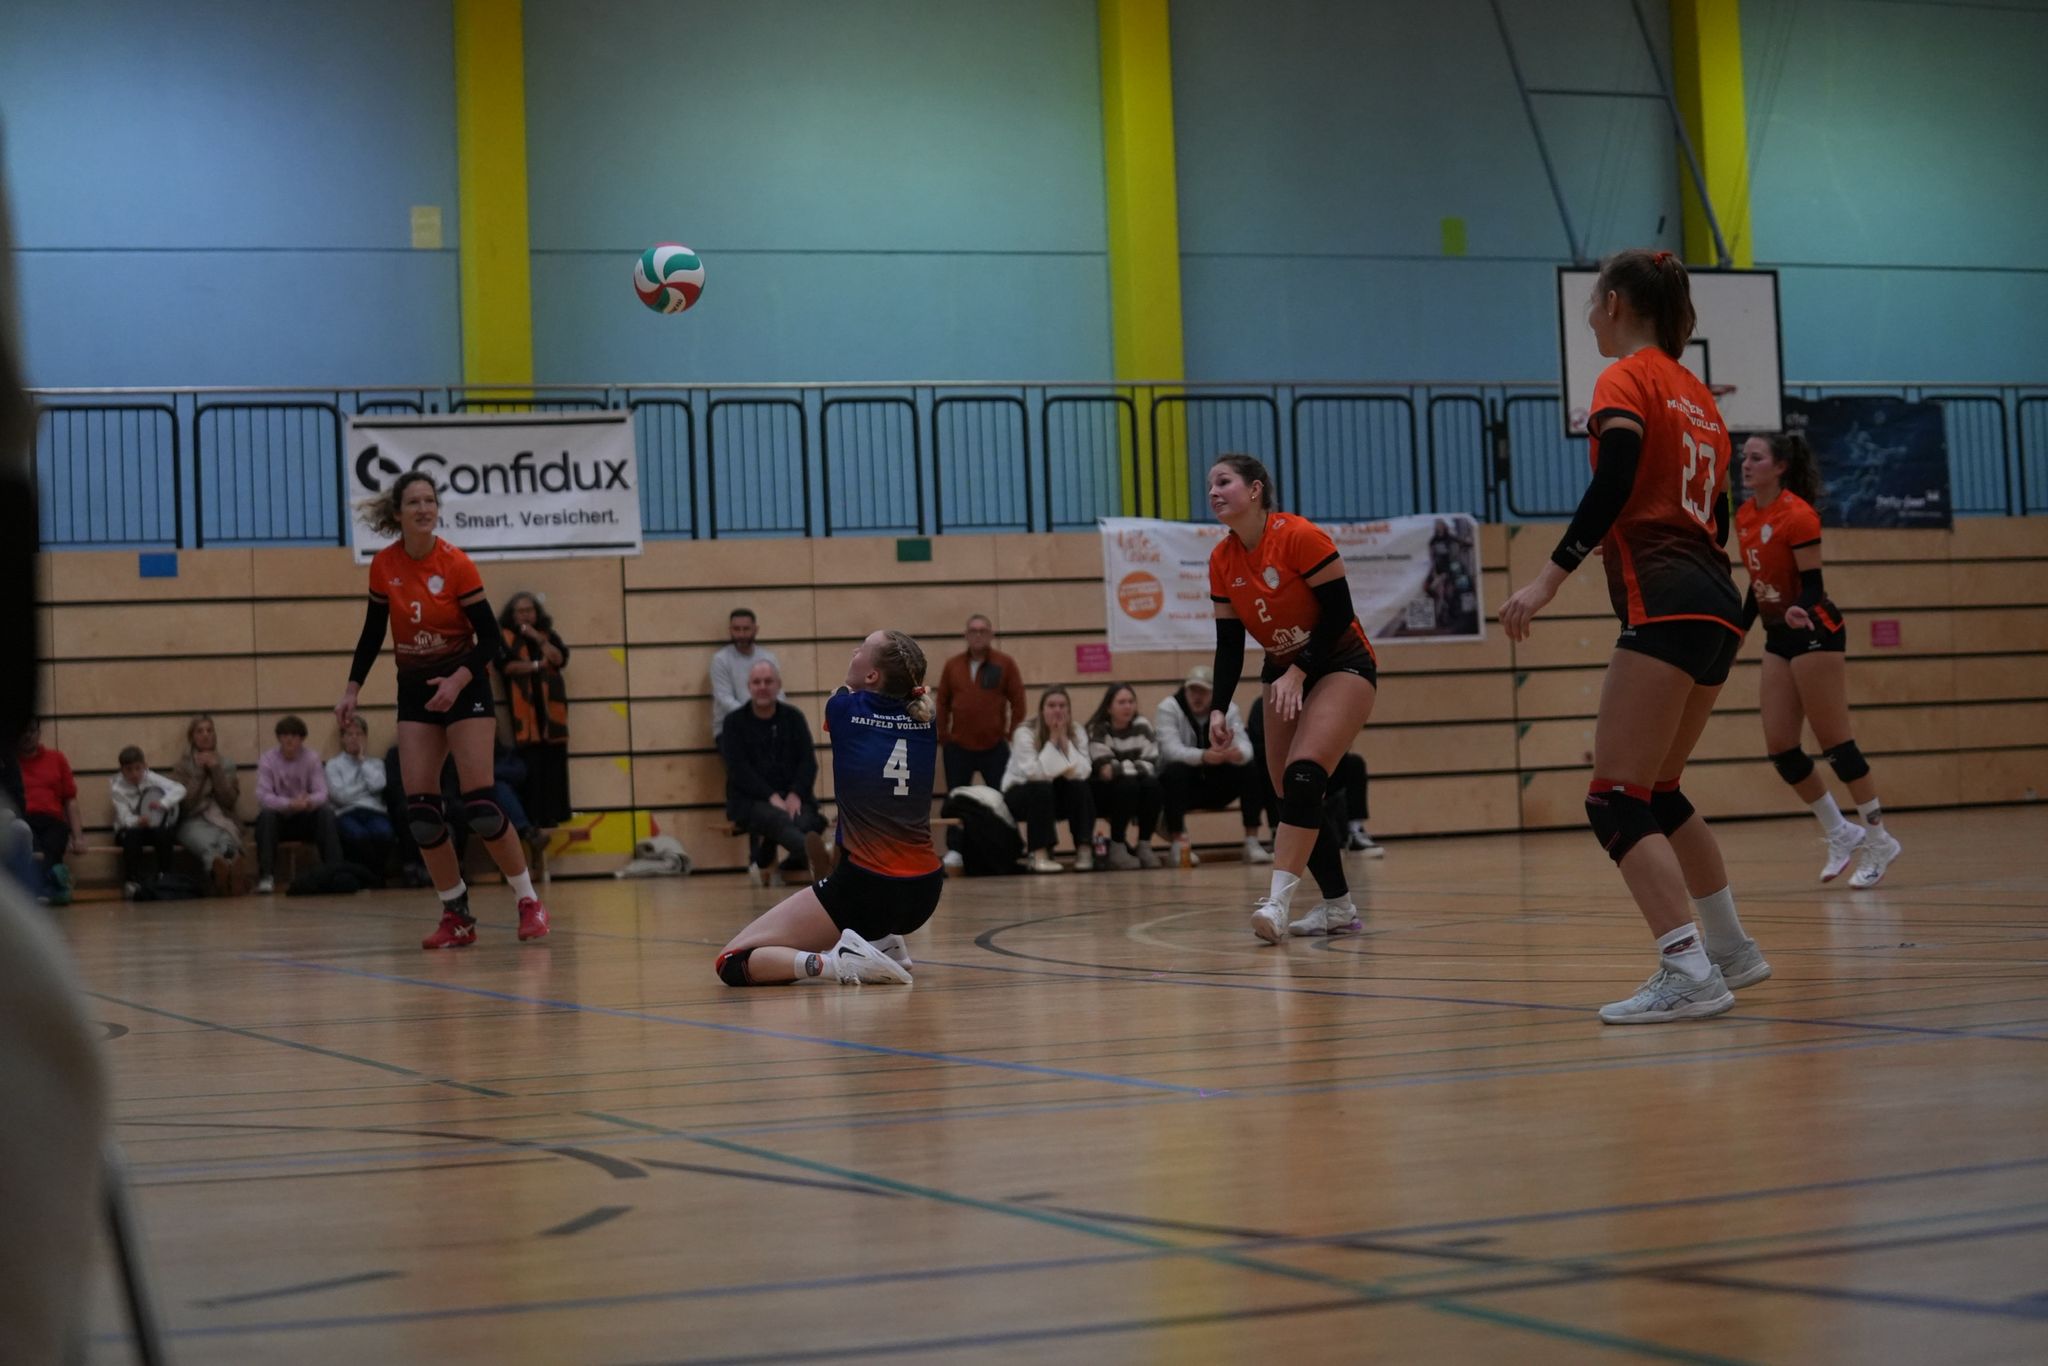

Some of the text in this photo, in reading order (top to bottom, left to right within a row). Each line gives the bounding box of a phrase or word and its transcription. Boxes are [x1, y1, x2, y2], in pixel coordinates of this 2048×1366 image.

[411, 450, 631, 494] Confidux
[1681, 431, 1717, 525] 23
[455, 512, 514, 529] Smart.
[520, 508, 619, 528] Versichert.
[410, 600, 422, 624] 3
[1254, 597, 1273, 624] 2
[851, 716, 894, 730] MAIFELD
[882, 738, 911, 796] 4
